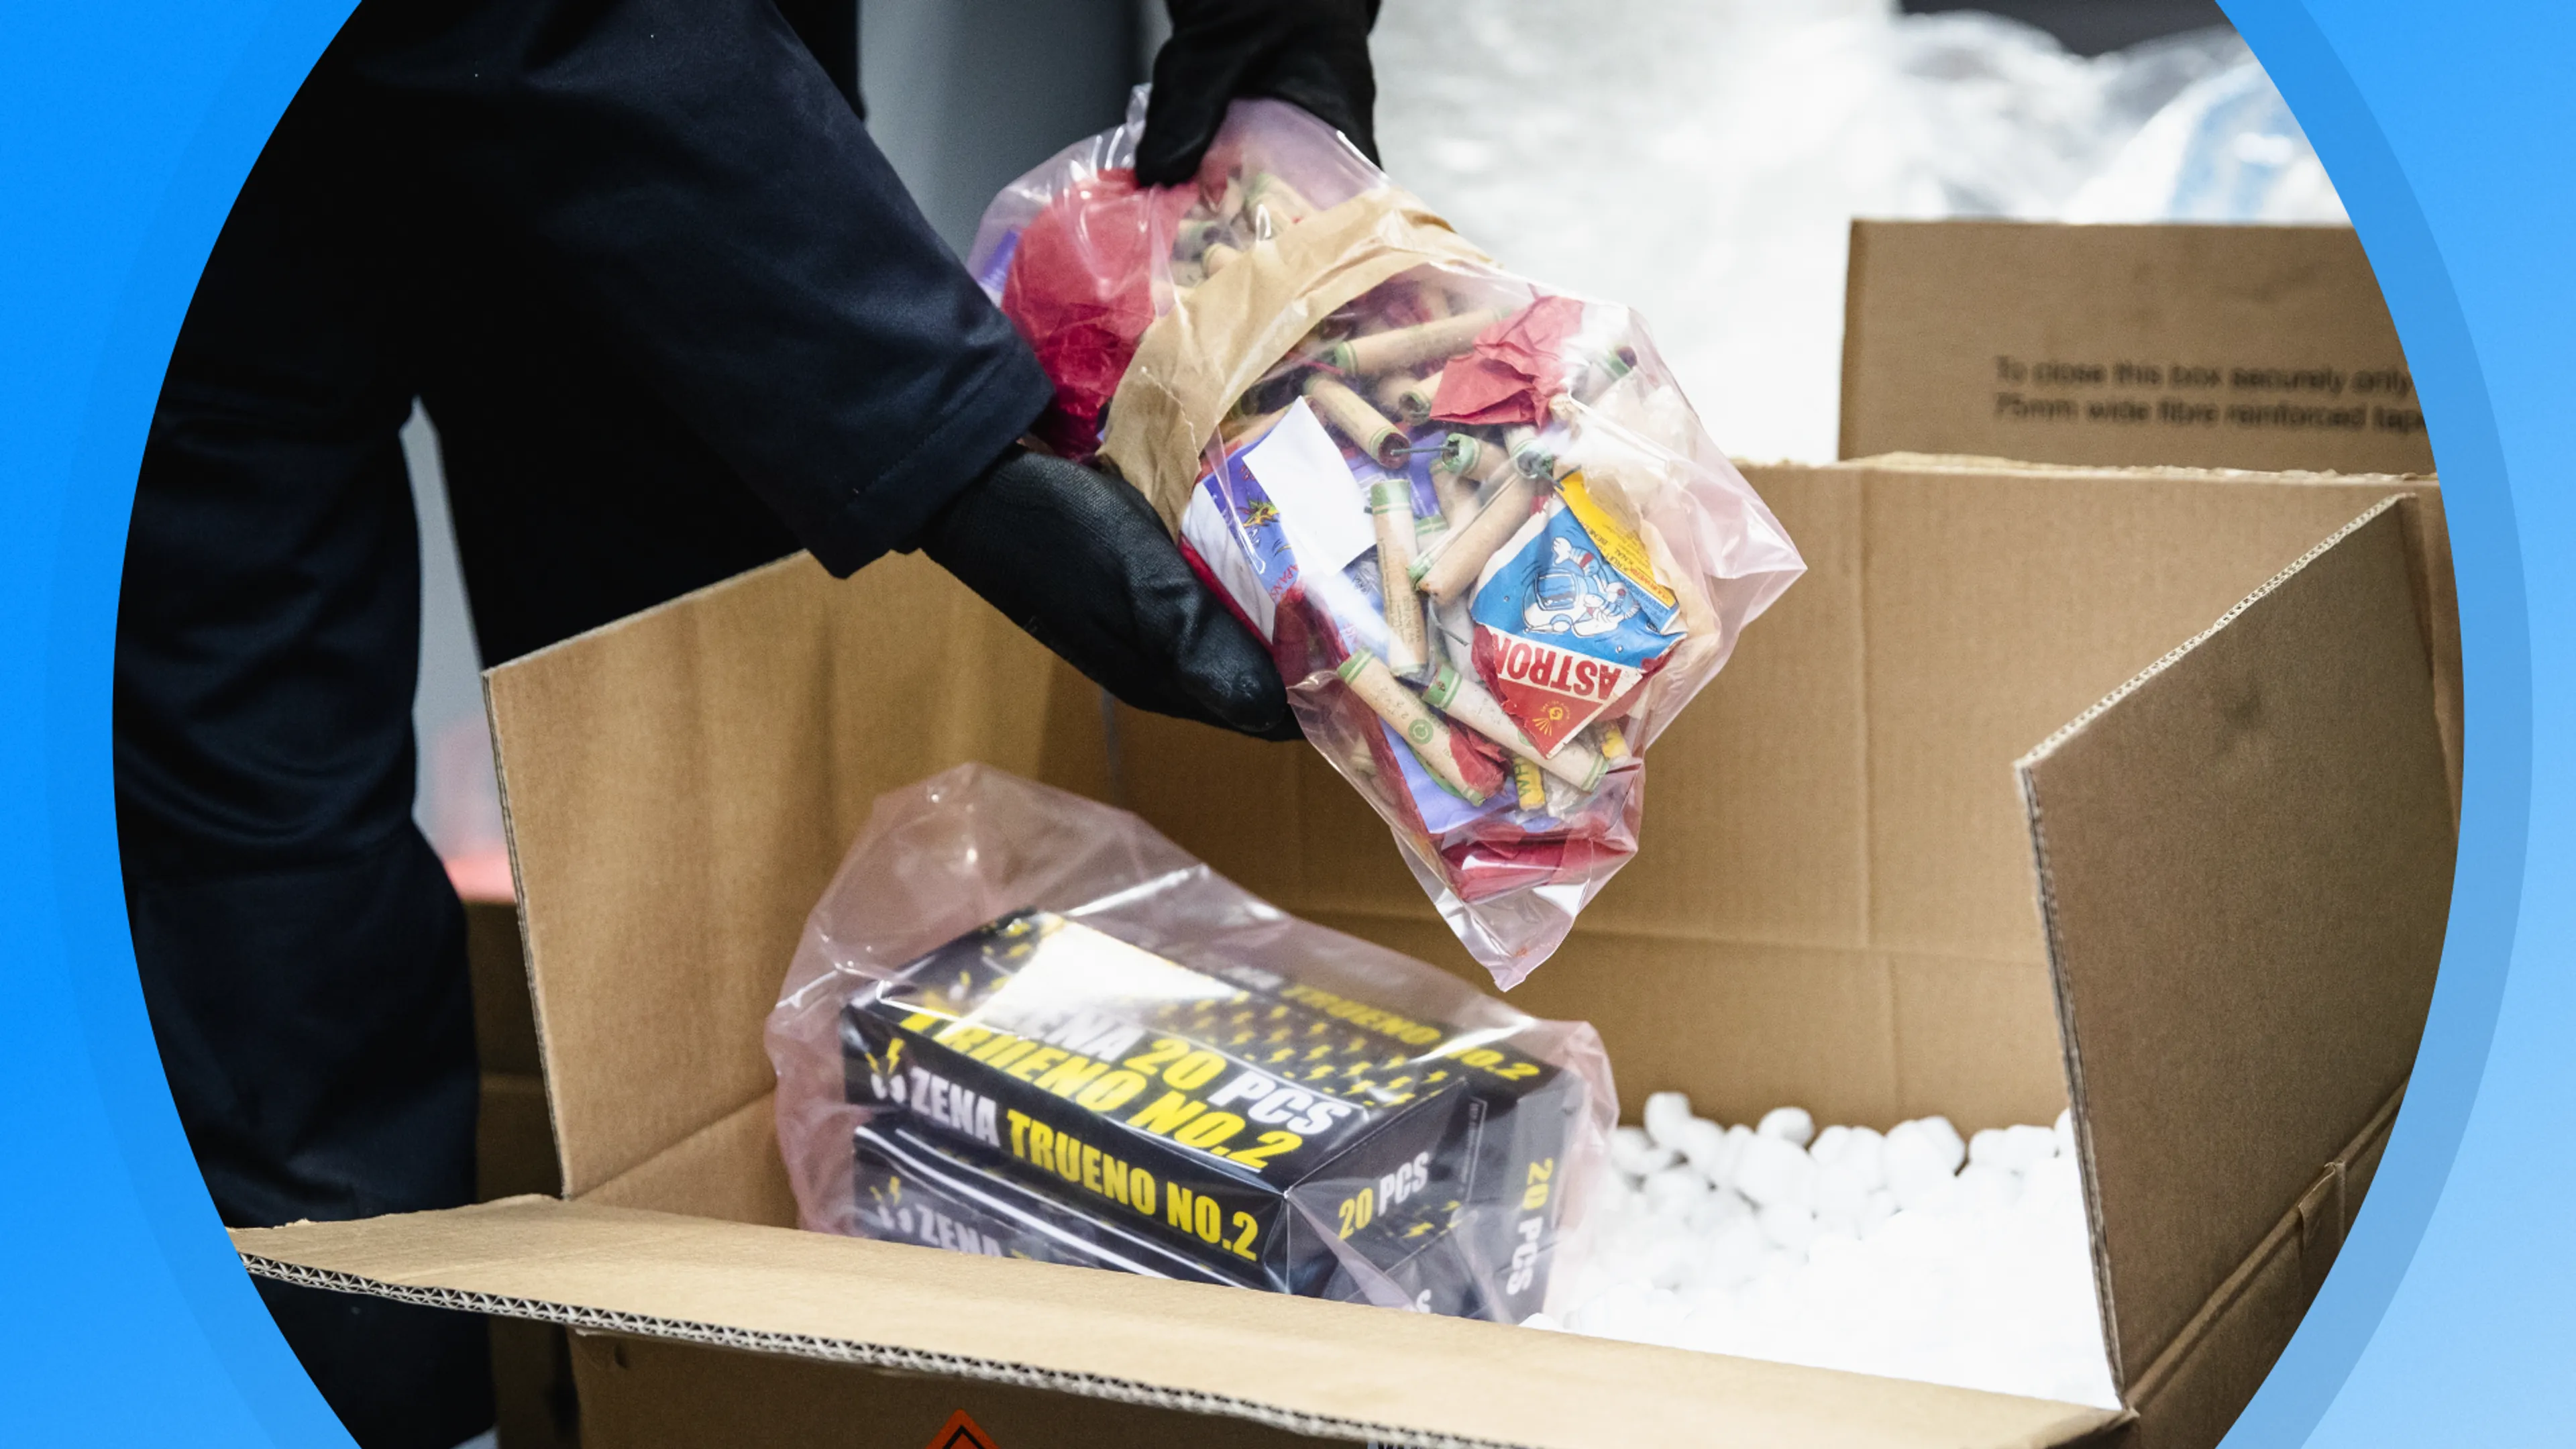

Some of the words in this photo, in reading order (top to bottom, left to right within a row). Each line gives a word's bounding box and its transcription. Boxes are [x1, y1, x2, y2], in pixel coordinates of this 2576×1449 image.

[2032, 361, 2105, 385] close
[2113, 361, 2162, 385] this
[2171, 365, 2221, 388] box
[2232, 366, 2344, 394] securely
[2352, 368, 2412, 397] only
[2087, 400, 2149, 423] wide
[2226, 402, 2366, 429] reinforced
[1281, 985, 1442, 1045] TRUENO
[1123, 1038, 1227, 1090] 20
[1208, 1071, 1352, 1135] PCS
[910, 1065, 1000, 1148] ZENA
[1007, 1109, 1156, 1216] TRUENO
[1167, 1181, 1258, 1261] NO.2
[1126, 1091, 1303, 1169] NO.2
[1338, 1187, 1373, 1240] 20
[1378, 1151, 1430, 1217] PCS
[1523, 1158, 1554, 1210] 20
[1506, 1217, 1543, 1295] PCS
